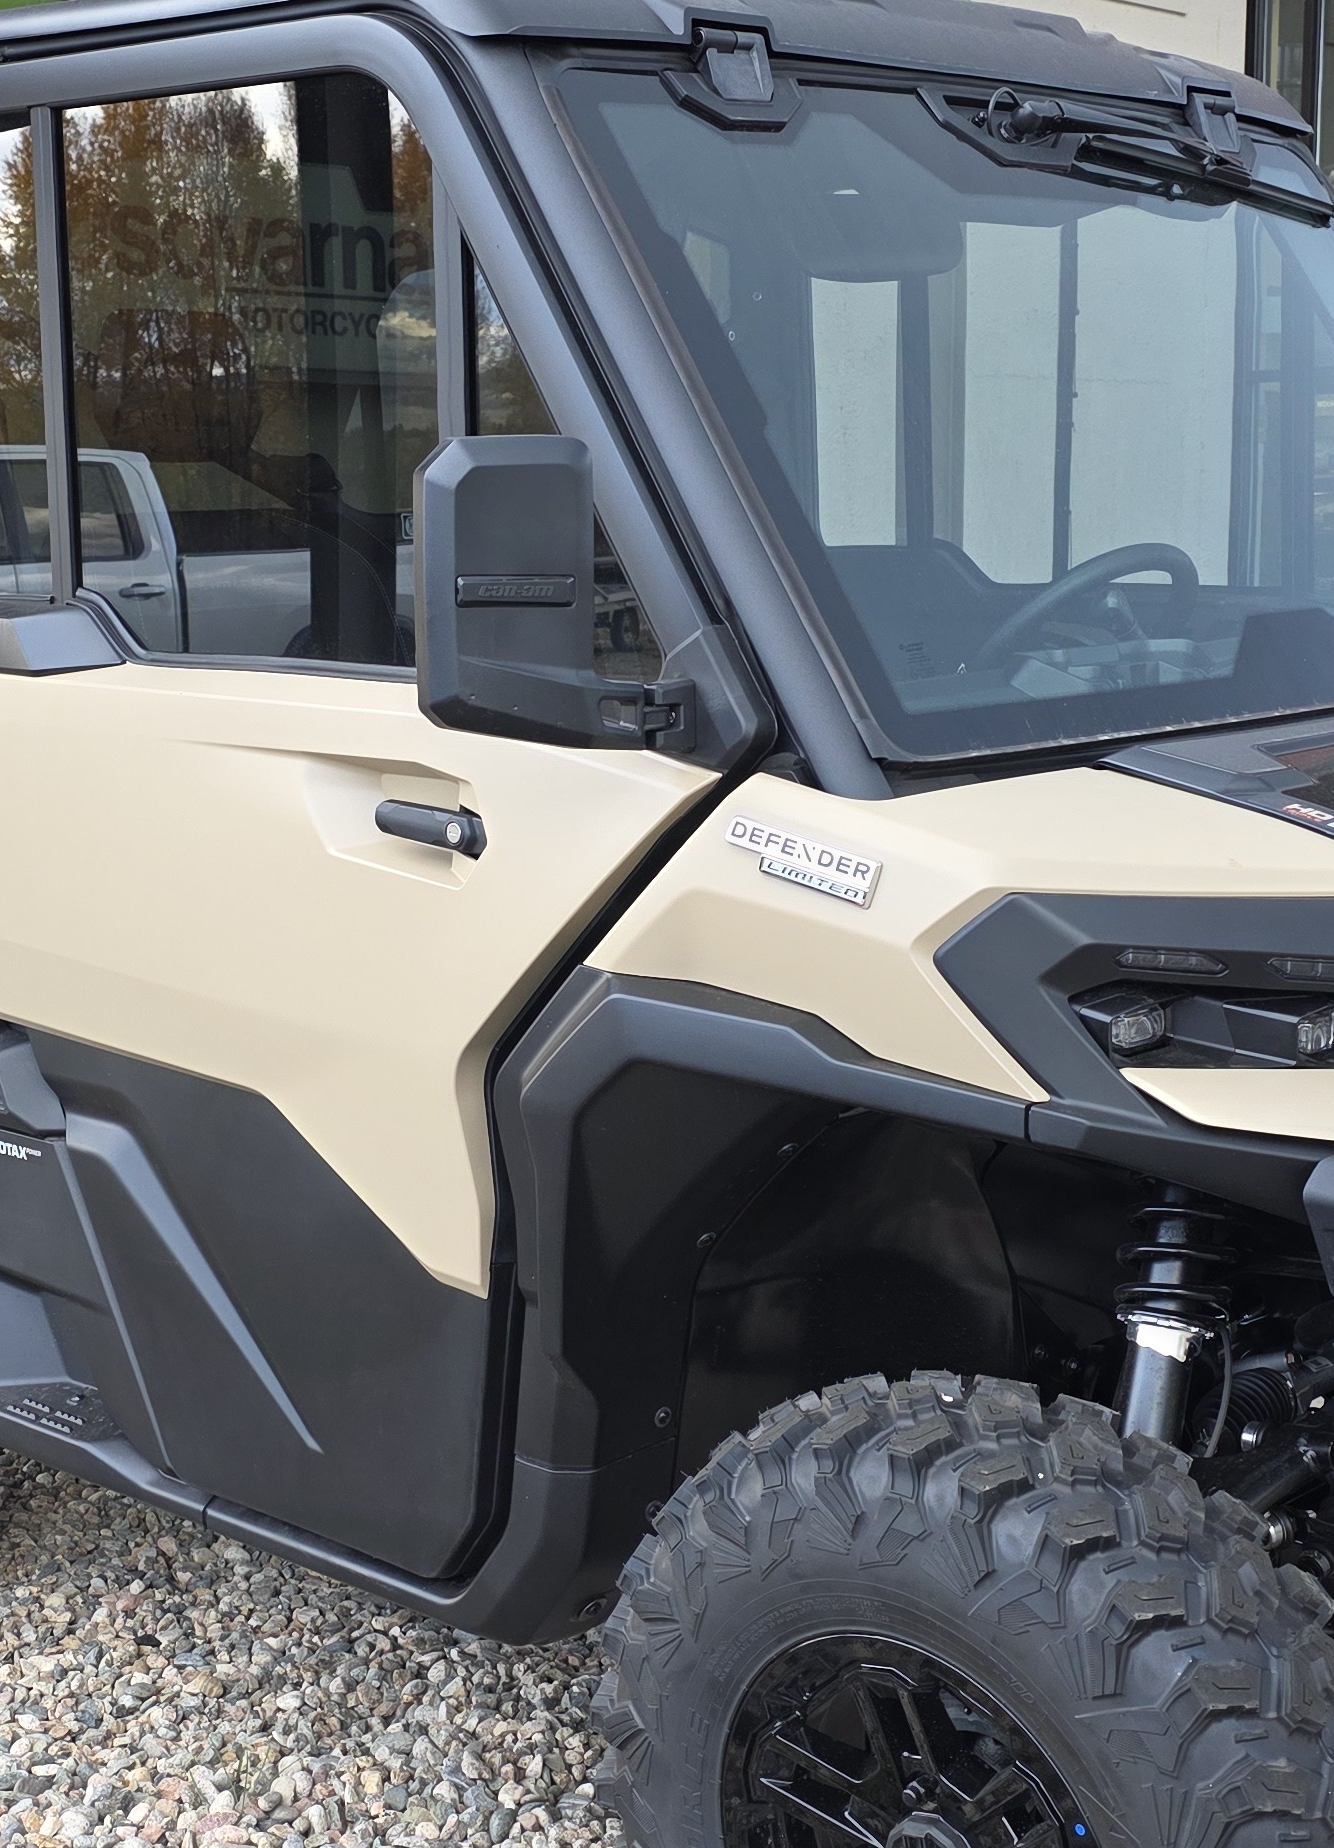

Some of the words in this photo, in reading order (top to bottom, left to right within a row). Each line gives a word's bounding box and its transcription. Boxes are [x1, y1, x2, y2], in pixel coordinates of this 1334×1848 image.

[478, 585, 555, 598] can-am
[730, 821, 871, 881] DEFENDER
[767, 861, 859, 899] LIMITED
